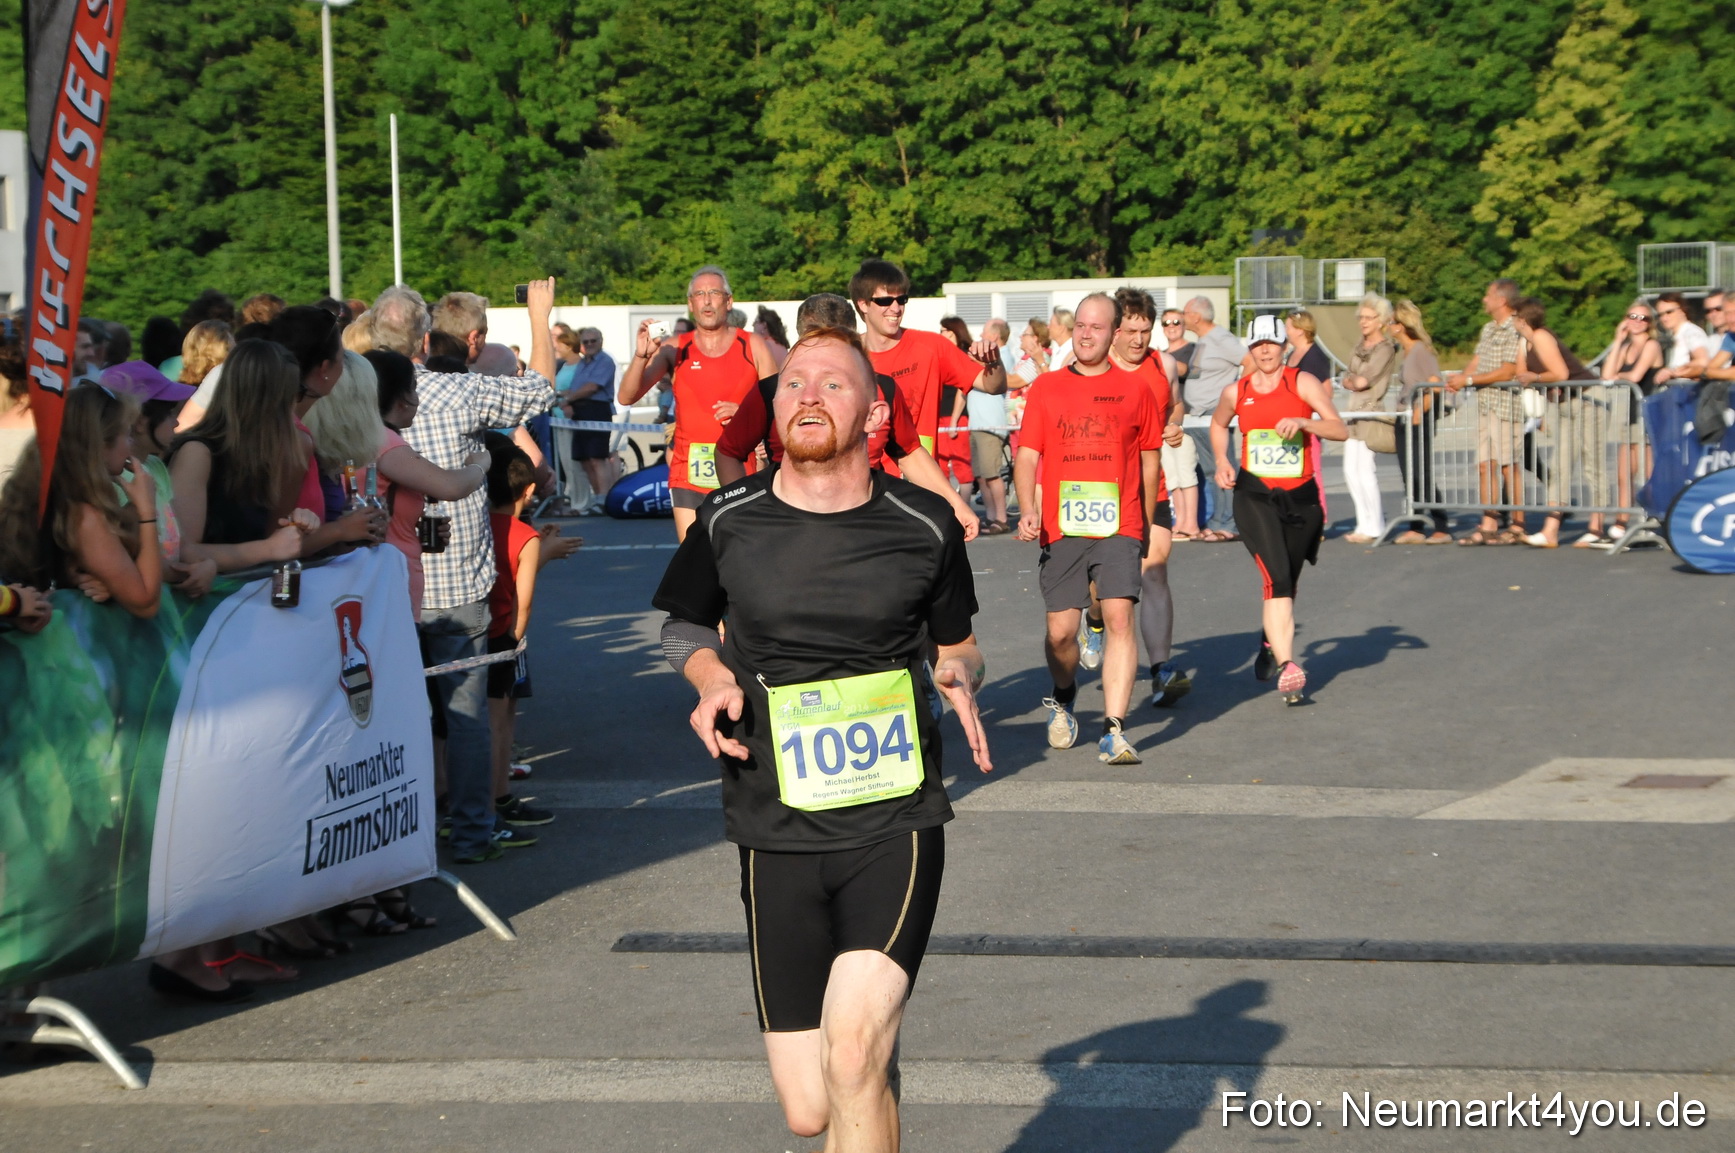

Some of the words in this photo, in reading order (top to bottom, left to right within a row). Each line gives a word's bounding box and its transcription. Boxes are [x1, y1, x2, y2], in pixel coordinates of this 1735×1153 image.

[1062, 454, 1086, 463] Alles
[1089, 453, 1112, 462] läuft
[1250, 446, 1300, 465] 1323
[724, 486, 747, 500] JAKO
[1062, 500, 1116, 523] 1356
[793, 701, 842, 716] firmenlauf
[781, 714, 914, 780] 1094
[325, 741, 405, 804] Neumarkter
[825, 776, 855, 787] Michael
[855, 772, 880, 783] Herbst
[812, 790, 839, 799] Regens
[840, 786, 866, 797] Wagner
[867, 780, 895, 792] Stiftung
[302, 783, 419, 877] Lammsbräu
